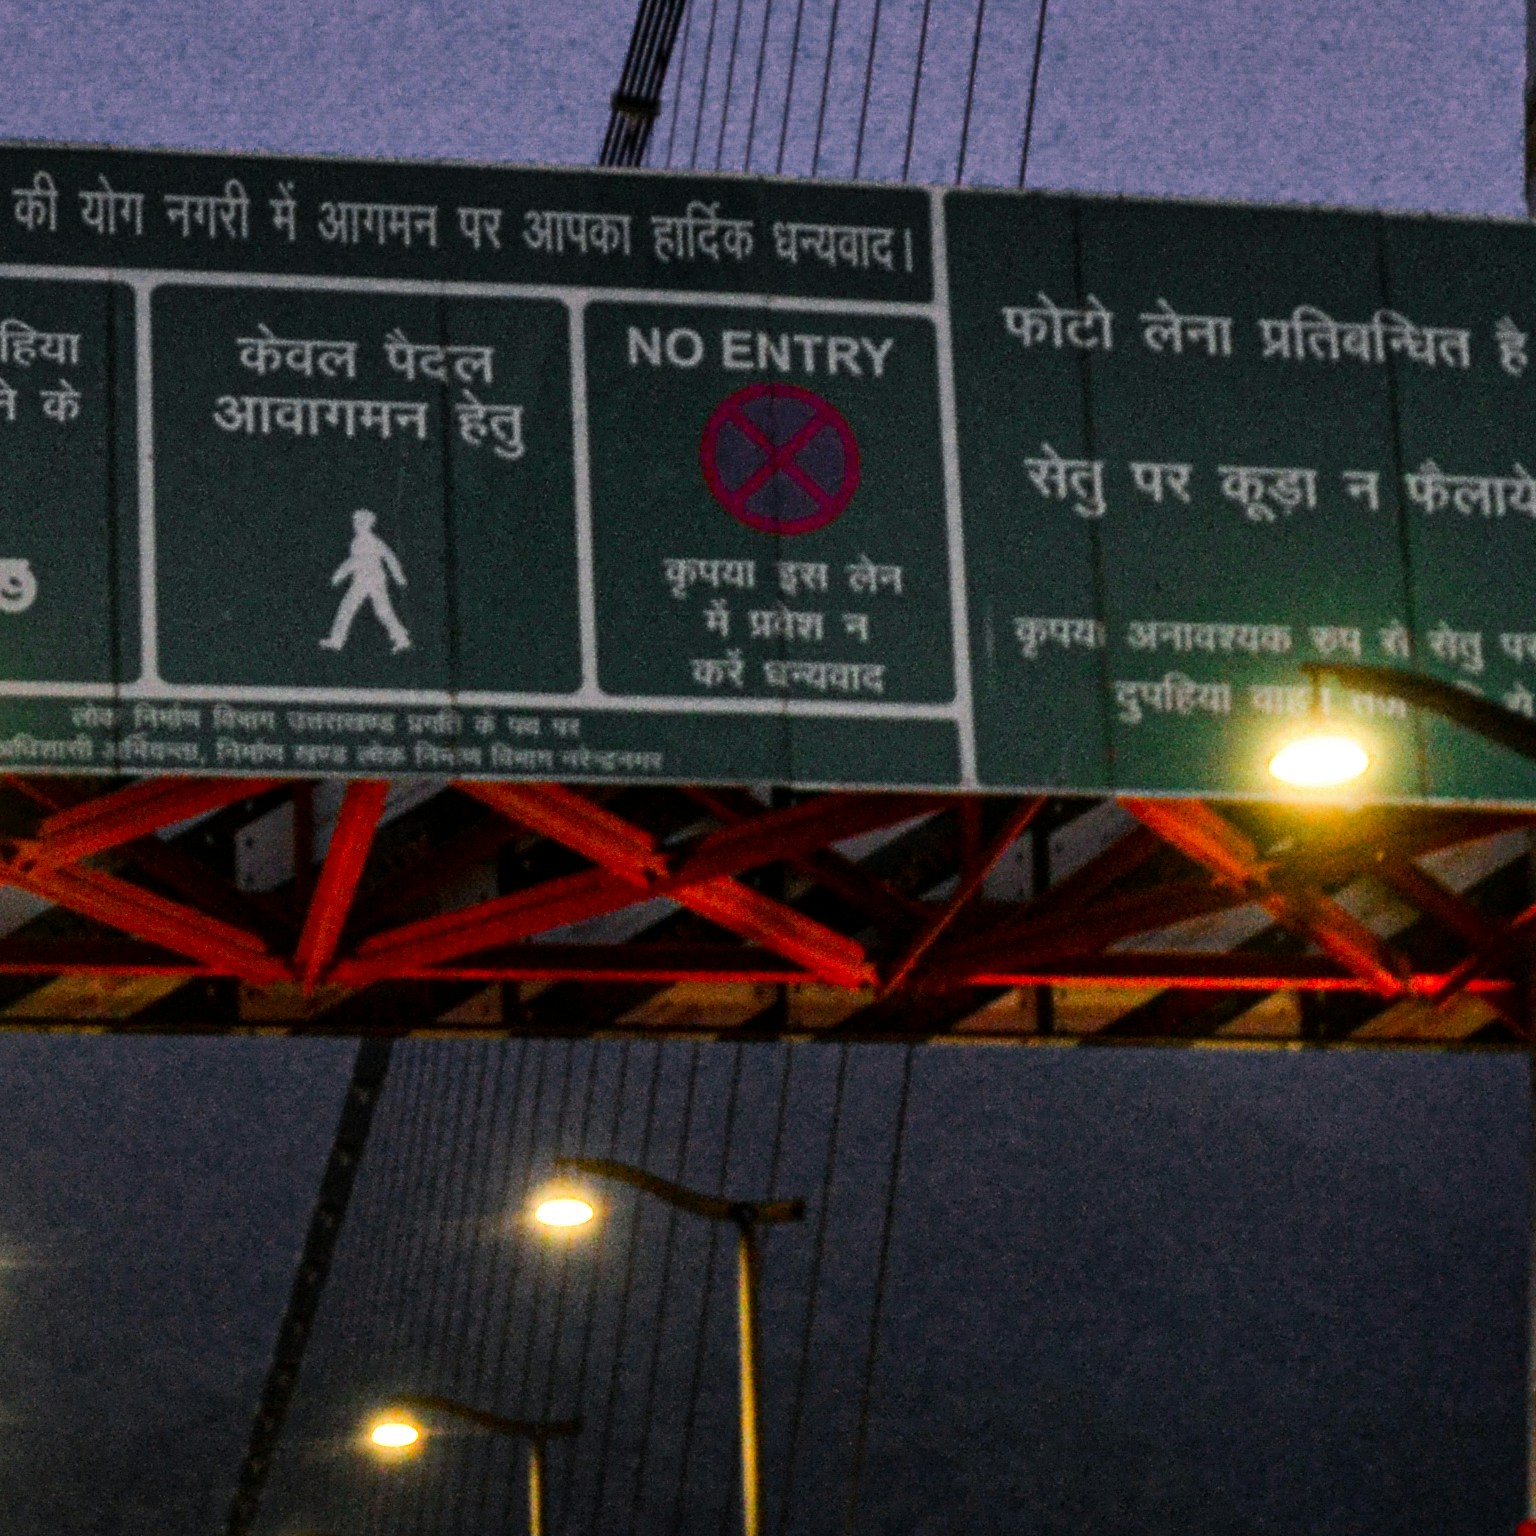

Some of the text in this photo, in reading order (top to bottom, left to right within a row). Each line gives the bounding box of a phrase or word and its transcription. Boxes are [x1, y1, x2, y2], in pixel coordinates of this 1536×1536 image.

[13, 171, 58, 232] की
[80, 174, 145, 234] योग
[165, 180, 250, 238] नगरी
[270, 183, 296, 241] में
[318, 201, 439, 247] आगमन
[458, 206, 502, 249] पर
[524, 209, 631, 256] आपका
[651, 201, 754, 263] हार्दिक
[1003, 292, 1114, 351] फोटो
[1140, 298, 1233, 356] लेना
[236, 323, 495, 384] केवल पैदल
[628, 327, 895, 378] NO ENTRY
[40, 378, 82, 421] के
[214, 390, 526, 461] आवागमन हेतु
[1024, 443, 1107, 519] सेतु
[1130, 462, 1193, 502] पर
[1342, 471, 1379, 510] न
[665, 553, 903, 600] कृपया इस लेन
[748, 601, 824, 641] प्रवेश
[842, 612, 869, 643] न
[1014, 617, 1105, 659] कृपया
[1128, 620, 1292, 654] अनावश्यक
[690, 648, 886, 694] करें धन्यवाद
[1115, 671, 1230, 724] दुपहिया
